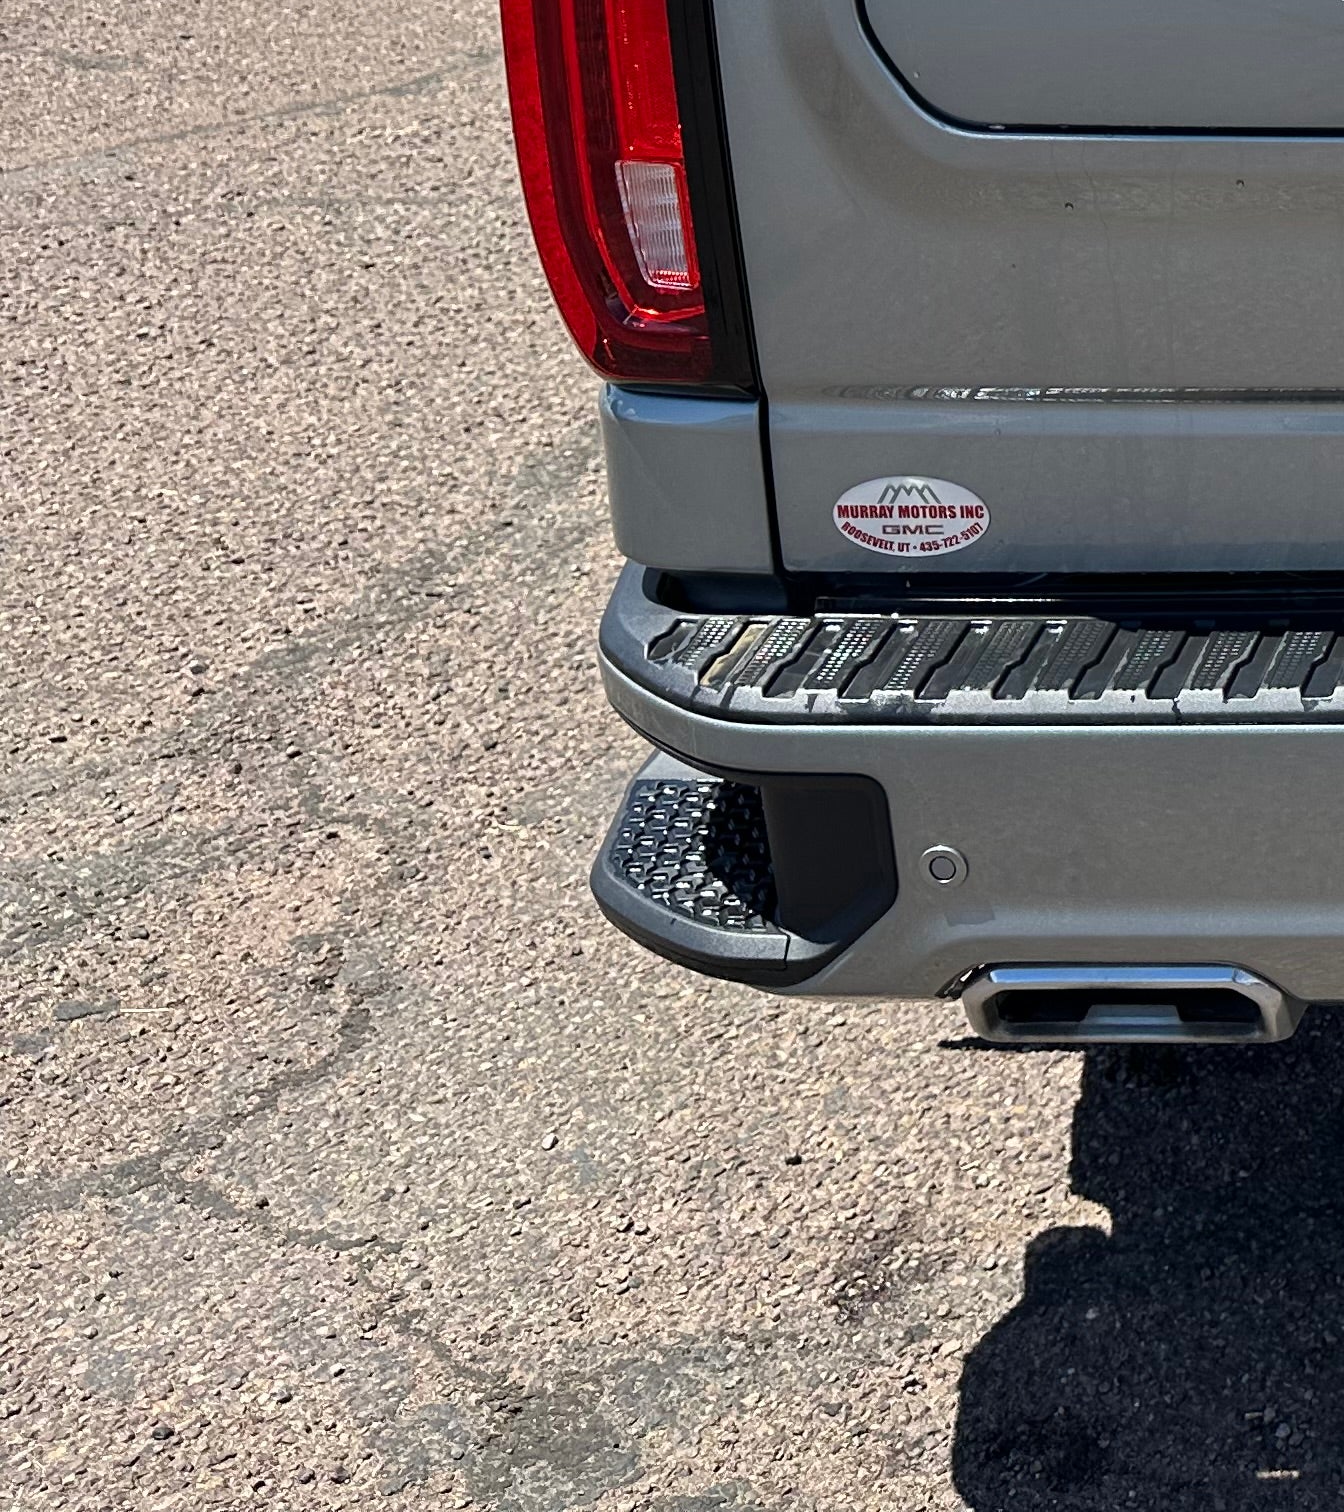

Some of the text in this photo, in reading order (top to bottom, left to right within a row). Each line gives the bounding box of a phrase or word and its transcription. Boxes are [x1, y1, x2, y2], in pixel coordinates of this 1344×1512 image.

[837, 504, 985, 519] MURRAY MOTORS INC
[841, 521, 985, 552] ROOSEVELT, UT 435-722-5107
[882, 524, 944, 535] GMC
